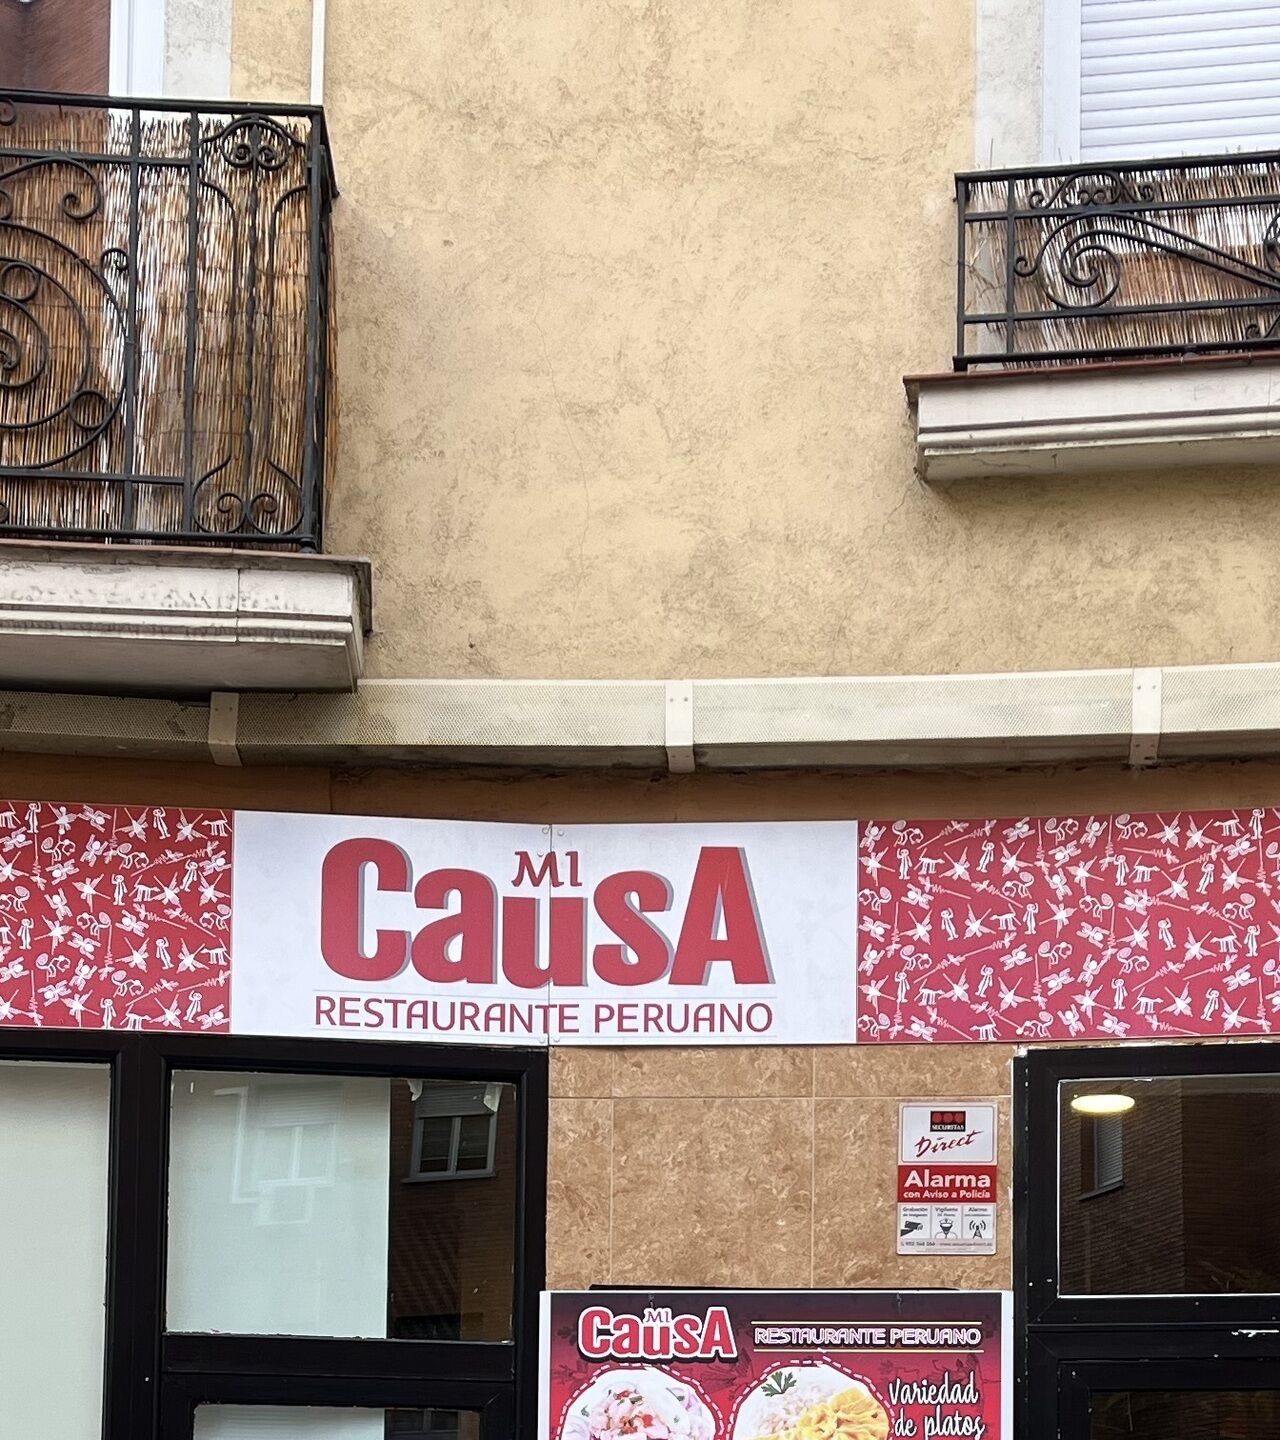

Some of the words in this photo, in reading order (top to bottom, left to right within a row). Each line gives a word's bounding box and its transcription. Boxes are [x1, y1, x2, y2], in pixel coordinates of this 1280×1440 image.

[510, 850, 582, 888] MI
[314, 996, 579, 1034] RESTAURANTE
[593, 1003, 773, 1034] PERUANO
[914, 1130, 984, 1158] Direct
[904, 1169, 991, 1188] Alarma
[903, 1191, 920, 1199] con
[923, 1190, 949, 1199] Aviso
[960, 1190, 991, 1199] Policía
[754, 1327, 886, 1346] RESTAURANTE
[889, 1327, 982, 1346] PERUANO
[889, 1371, 979, 1405] Variedad
[894, 1407, 917, 1436] de
